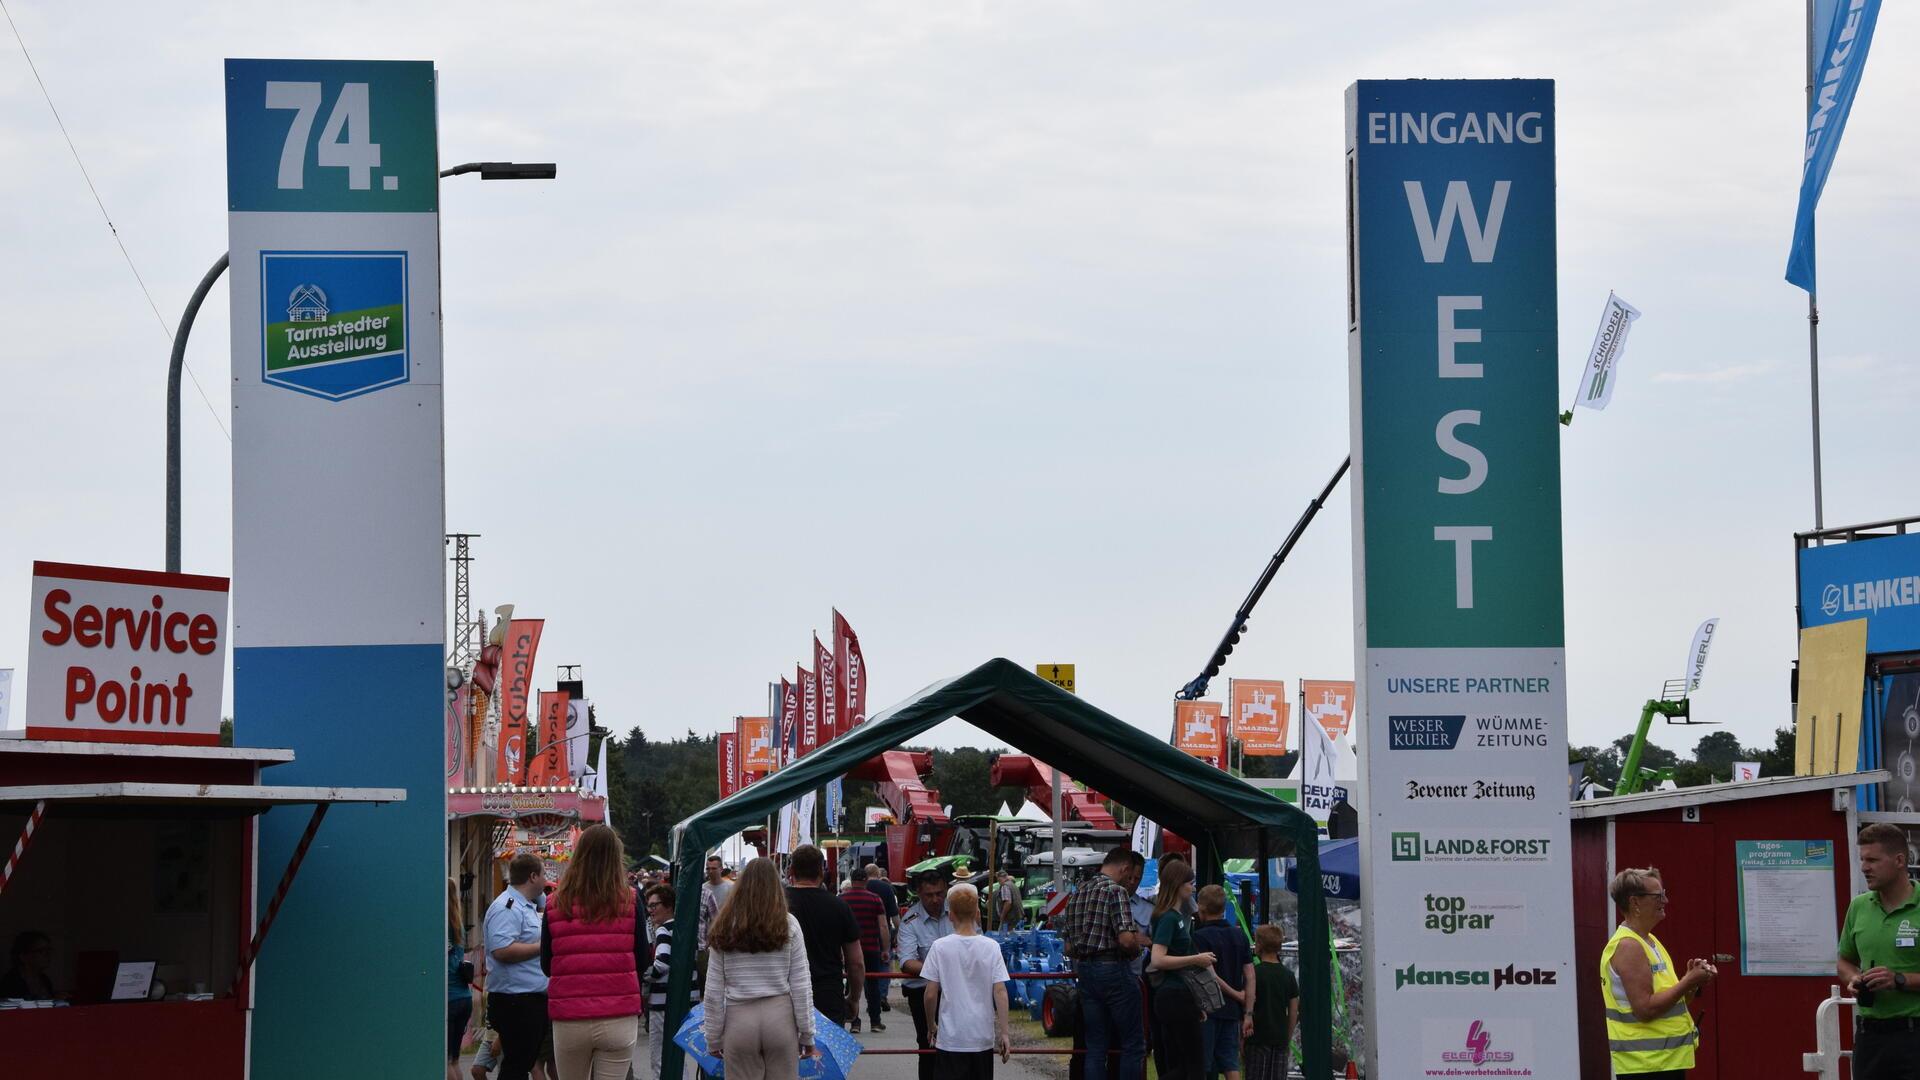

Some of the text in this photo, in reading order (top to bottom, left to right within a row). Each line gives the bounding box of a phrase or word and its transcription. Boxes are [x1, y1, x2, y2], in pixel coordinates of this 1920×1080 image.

[1801, 0, 1863, 188] EMKE
[265, 81, 399, 191] 74.
[1368, 112, 1543, 144] EINGANG
[285, 313, 390, 344] Tarmstedter
[1593, 310, 1621, 371] SCHRÖDER
[287, 332, 388, 361] Ausstellung
[1403, 180, 1512, 609] WEST
[42, 588, 218, 656] Service
[508, 634, 531, 728] Kubota
[1387, 678, 1550, 693] UNSERE PARTNER
[65, 665, 193, 726] Point
[1392, 719, 1445, 732] WESER
[1476, 715, 1548, 730] WÜMME-
[1394, 734, 1451, 746] KURIER
[1477, 735, 1547, 747] ZEITUNG
[726, 740, 734, 784] HORSCH
[1406, 780, 1536, 801] Zevener Zeitung
[1687, 808, 1695, 819] 8
[1424, 839, 1550, 855] LAND&FORST
[1756, 842, 1784, 850] Tages-
[1424, 893, 1465, 914] top
[1425, 913, 1494, 934] agrar
[1395, 963, 1557, 991] Hansa Holz
[1425, 1068, 1532, 1076] www.dein-werbetechniker.de
